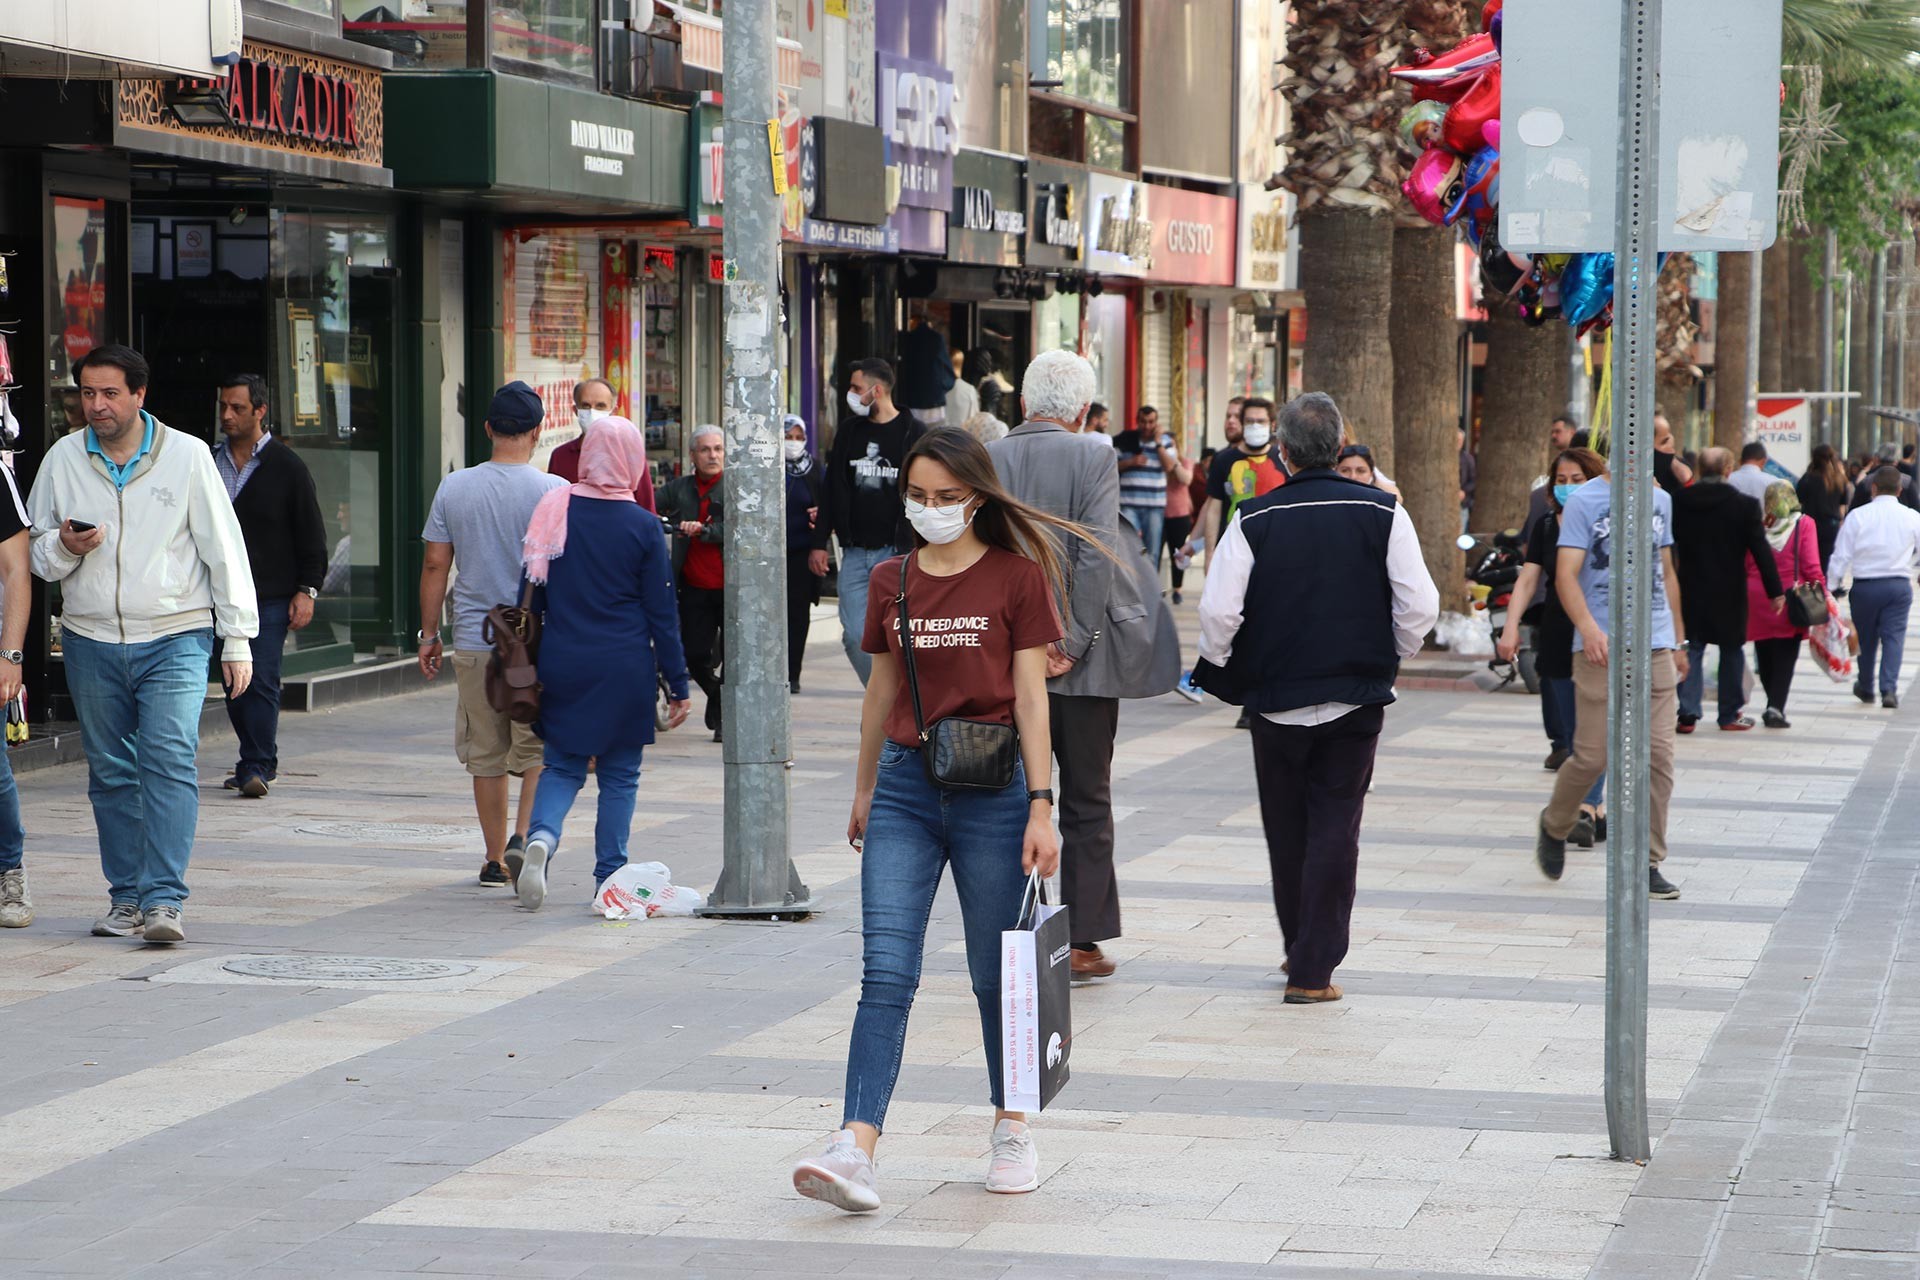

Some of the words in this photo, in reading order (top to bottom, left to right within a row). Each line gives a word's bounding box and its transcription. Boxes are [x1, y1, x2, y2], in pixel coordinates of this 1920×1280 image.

[964, 185, 992, 230] MAD
[810, 222, 835, 242] DAĞ
[925, 618, 952, 632] NEED
[952, 616, 989, 631] ADVICE
[915, 634, 941, 648] NEED
[941, 633, 982, 647] COFFEE.
